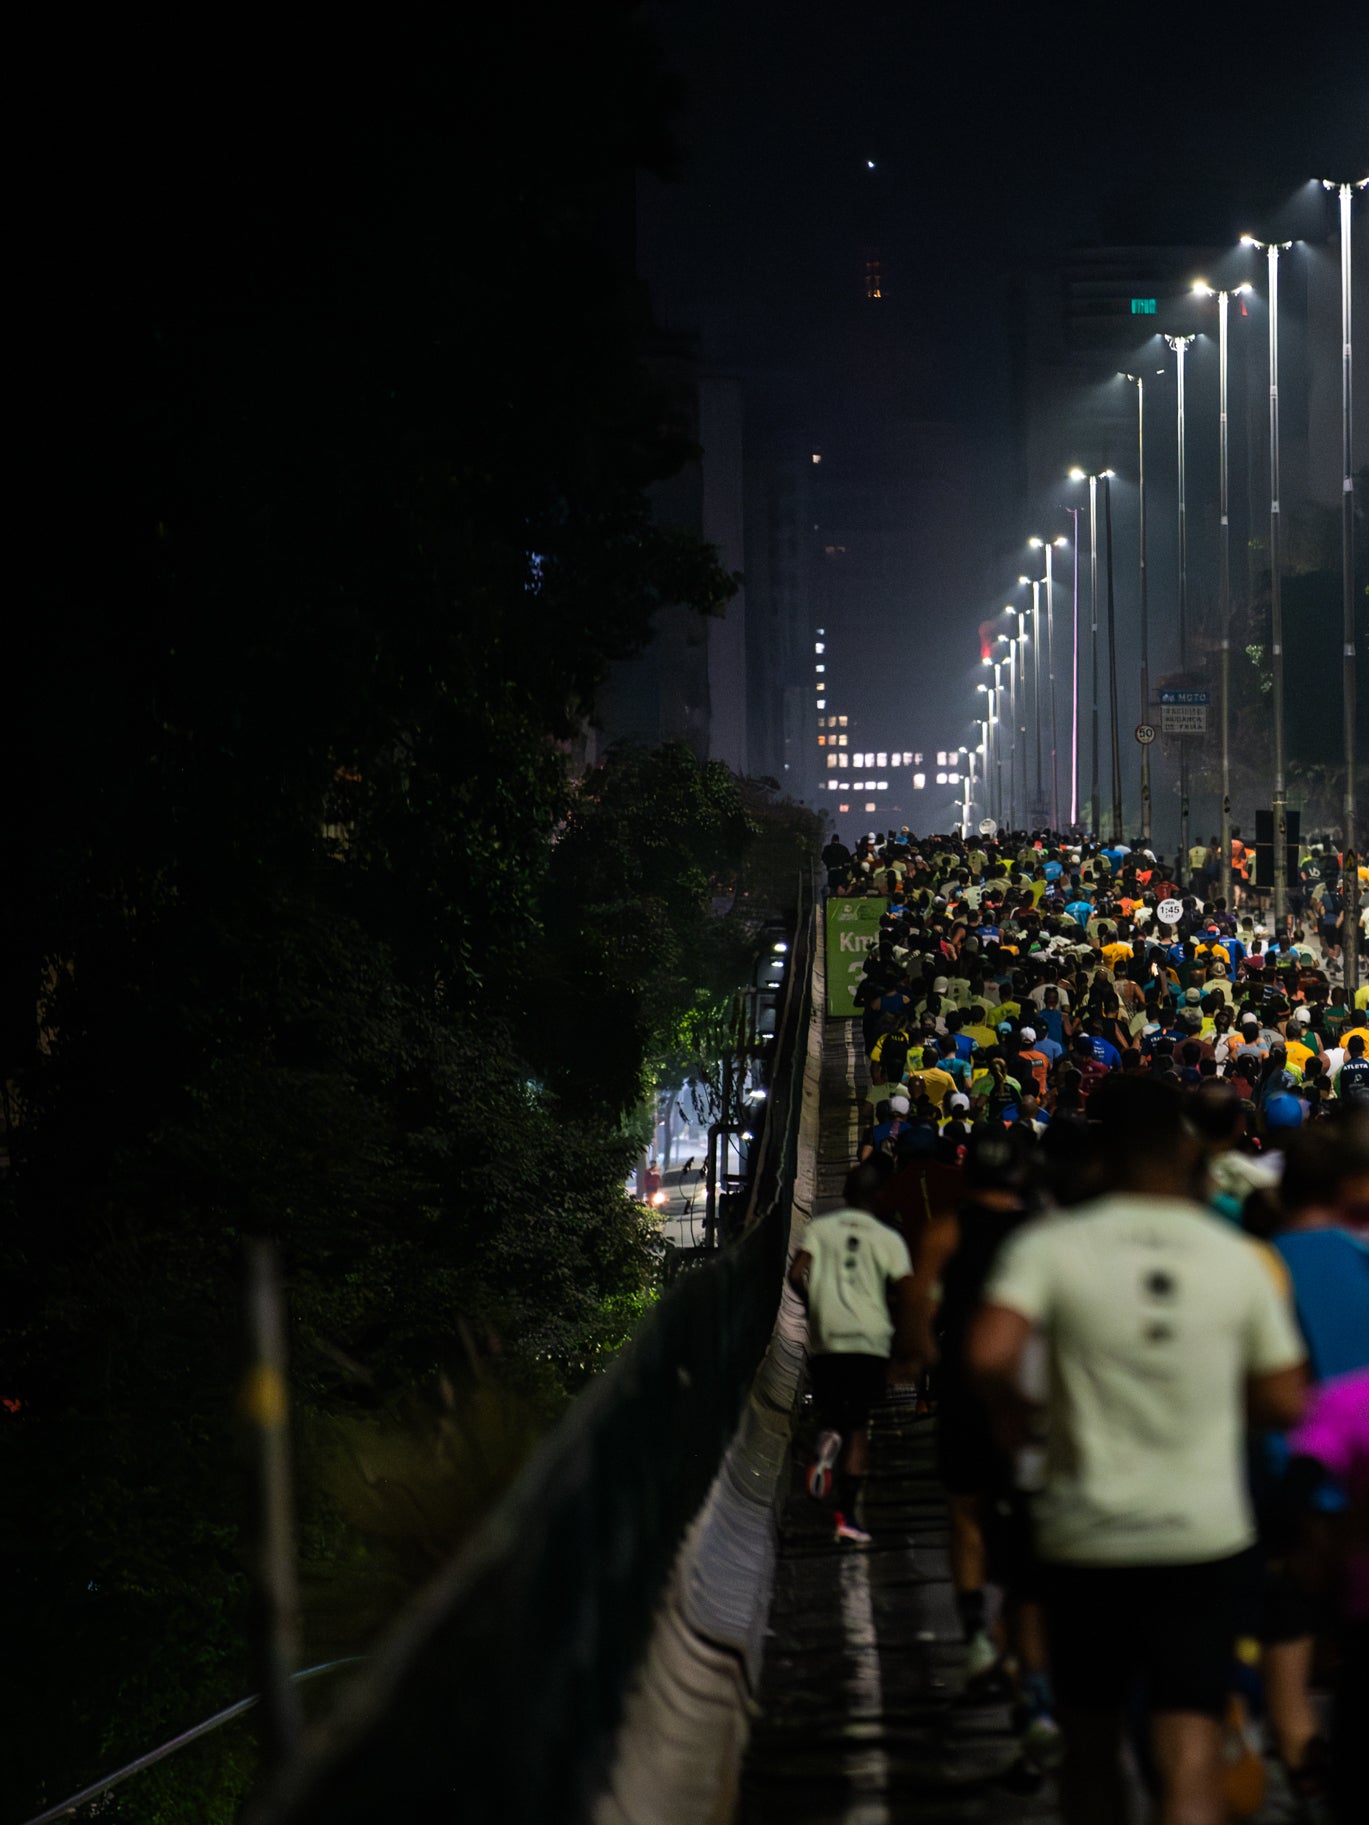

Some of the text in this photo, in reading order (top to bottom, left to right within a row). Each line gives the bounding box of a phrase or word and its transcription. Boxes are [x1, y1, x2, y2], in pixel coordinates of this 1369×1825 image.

[1178, 693, 1207, 702] MOTO
[1139, 728, 1153, 738] 50
[1343, 1063, 1369, 1071] ATLETA
